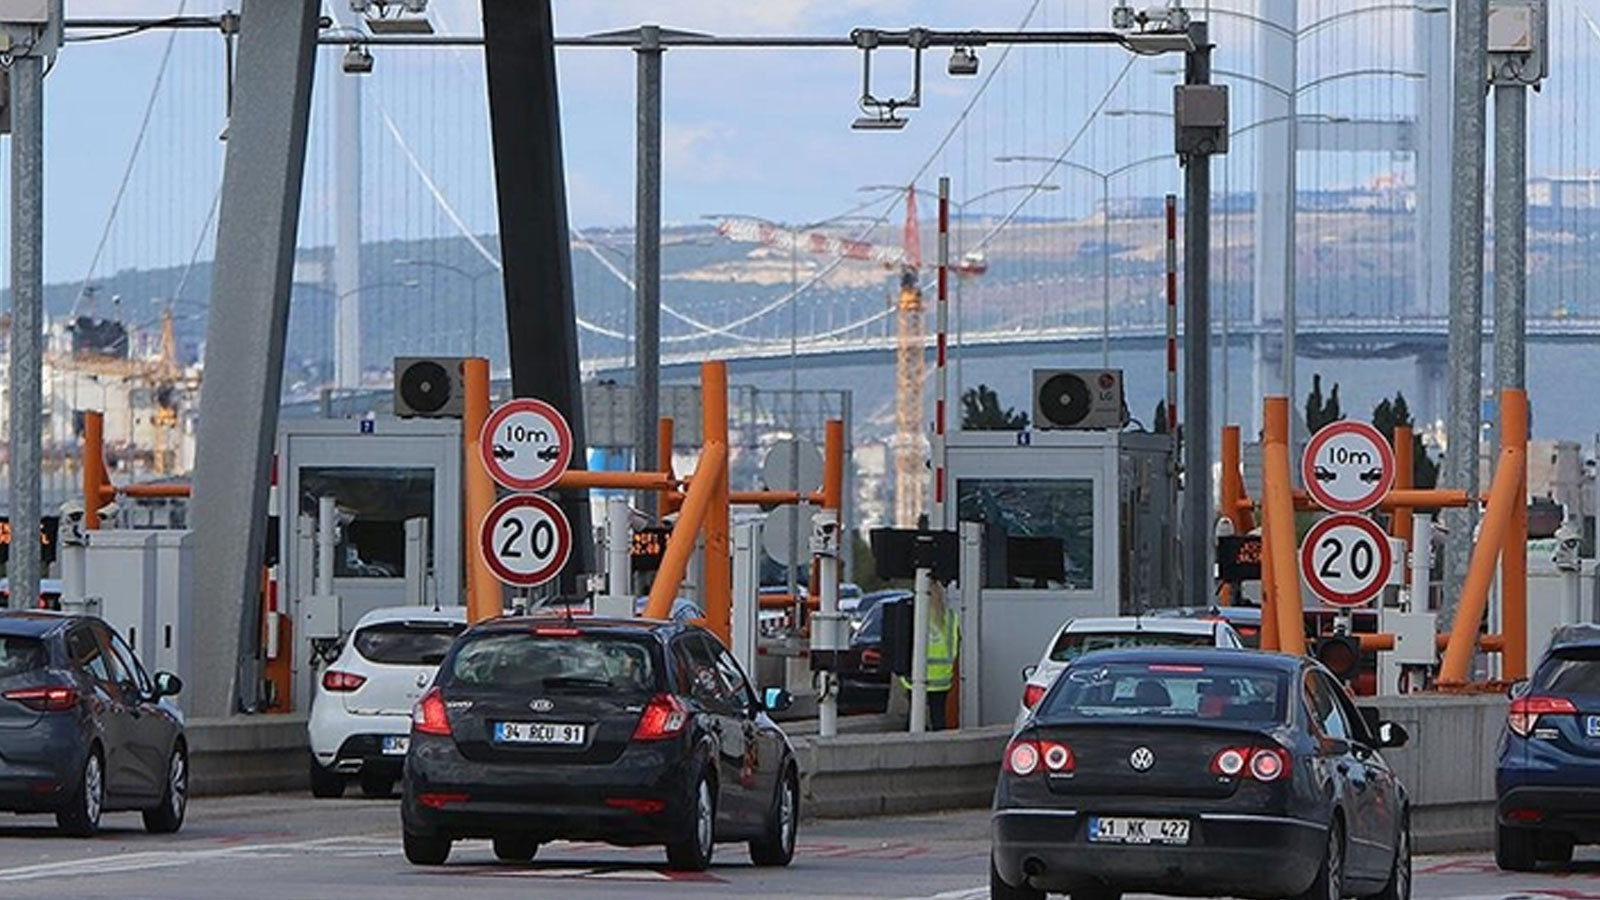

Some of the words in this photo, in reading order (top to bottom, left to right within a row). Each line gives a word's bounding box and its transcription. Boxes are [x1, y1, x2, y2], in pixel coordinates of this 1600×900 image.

[1100, 391, 1113, 401] LG
[506, 425, 548, 442] 10m
[1329, 447, 1371, 464] 10m
[500, 517, 553, 560] 20
[1320, 538, 1373, 580] 20
[504, 724, 519, 739] 34
[563, 726, 579, 741] 91
[1099, 820, 1114, 834] 41
[1127, 821, 1146, 836] NK
[1161, 822, 1187, 837] 427
